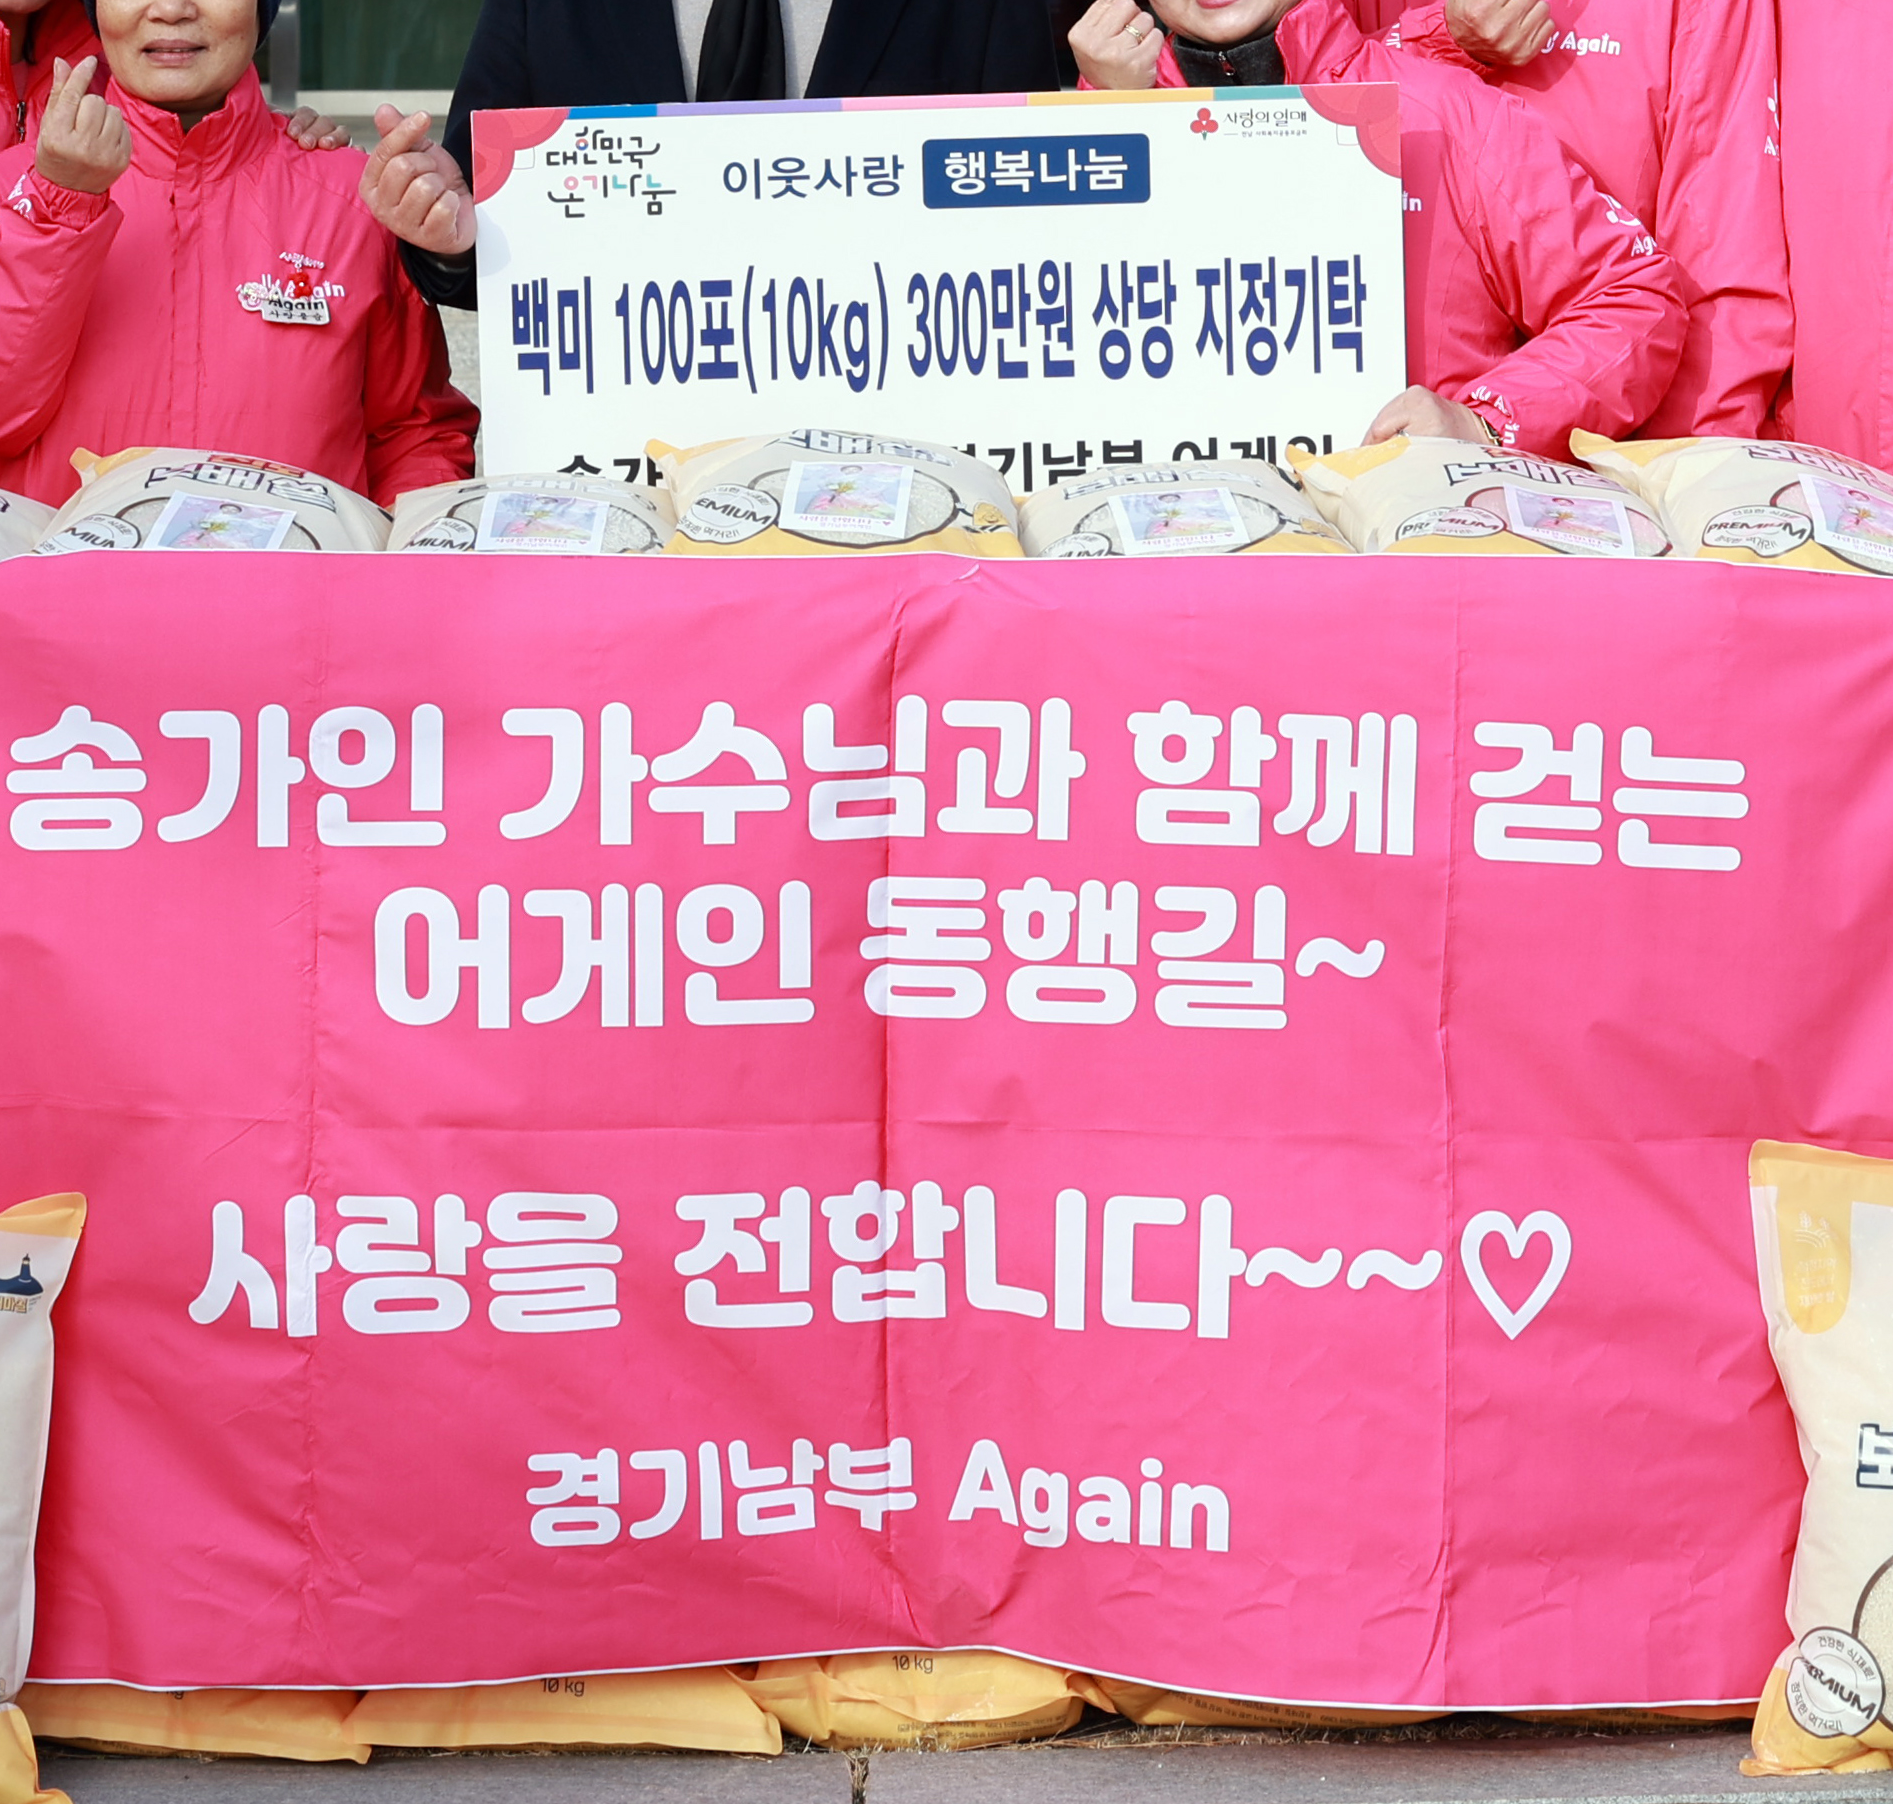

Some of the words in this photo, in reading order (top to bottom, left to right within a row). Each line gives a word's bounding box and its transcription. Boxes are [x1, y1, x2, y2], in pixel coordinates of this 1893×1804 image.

[1560, 32, 1621, 56] Again
[546, 126, 661, 169] 대한민국
[723, 155, 904, 199] 이웃사랑
[945, 149, 1127, 194] 행복나눔
[547, 174, 677, 218] 온기나눔
[284, 280, 345, 298] Aain
[512, 276, 593, 395] 백미
[616, 262, 888, 393] 100포(10kg)
[908, 260, 1074, 379] 300만원
[1092, 260, 1176, 380] 상당
[1196, 255, 1366, 376] 지정기탁
[694, 497, 772, 525] EMIUM
[1401, 518, 1501, 536] PRMIUM
[1708, 520, 1807, 541] PREMIUM
[6, 704, 446, 850] 송가인
[500, 695, 1085, 845] 가수님과
[1127, 701, 1417, 855] 함께
[1470, 722, 1748, 870] 걷는
[375, 881, 814, 1028] 어게인
[860, 876, 1384, 1029] 동행길~
[189, 1192, 622, 1337] 사랑을
[527, 1437, 916, 1546] 경기남부
[948, 1444, 1229, 1552] Again
[1817, 1635, 1845, 1652] 건강한
[891, 1654, 911, 1672] 10
[914, 1654, 935, 1675] kg
[539, 1677, 560, 1694] 10
[564, 1676, 586, 1698] kg
